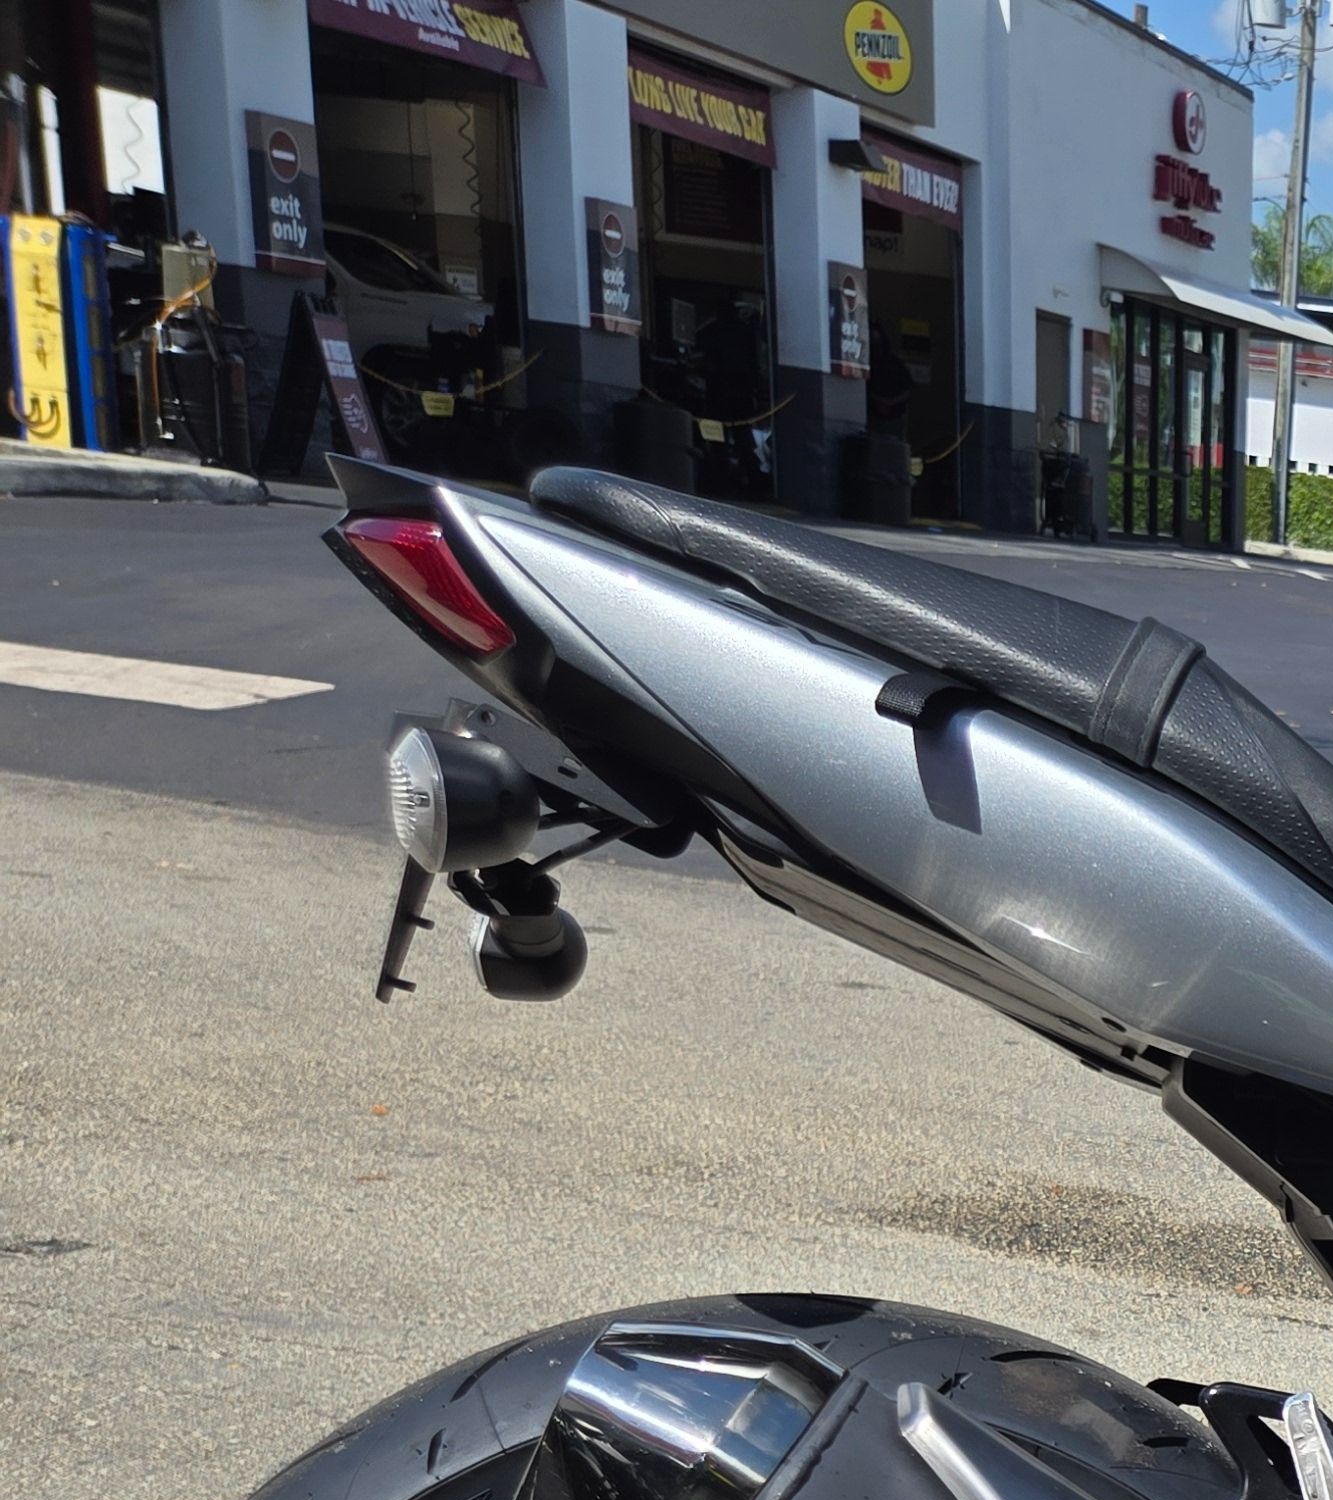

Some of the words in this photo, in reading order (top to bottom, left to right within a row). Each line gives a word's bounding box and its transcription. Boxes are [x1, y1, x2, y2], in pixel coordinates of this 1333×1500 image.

[855, 31, 903, 60] PENNZOIL
[628, 66, 672, 114] LONG
[668, 80, 704, 125] LIVE
[701, 91, 742, 138] YOUR
[902, 162, 931, 203] THAN
[271, 194, 302, 219] exit
[272, 219, 307, 249] only
[603, 266, 626, 288] exit
[604, 286, 630, 312] only
